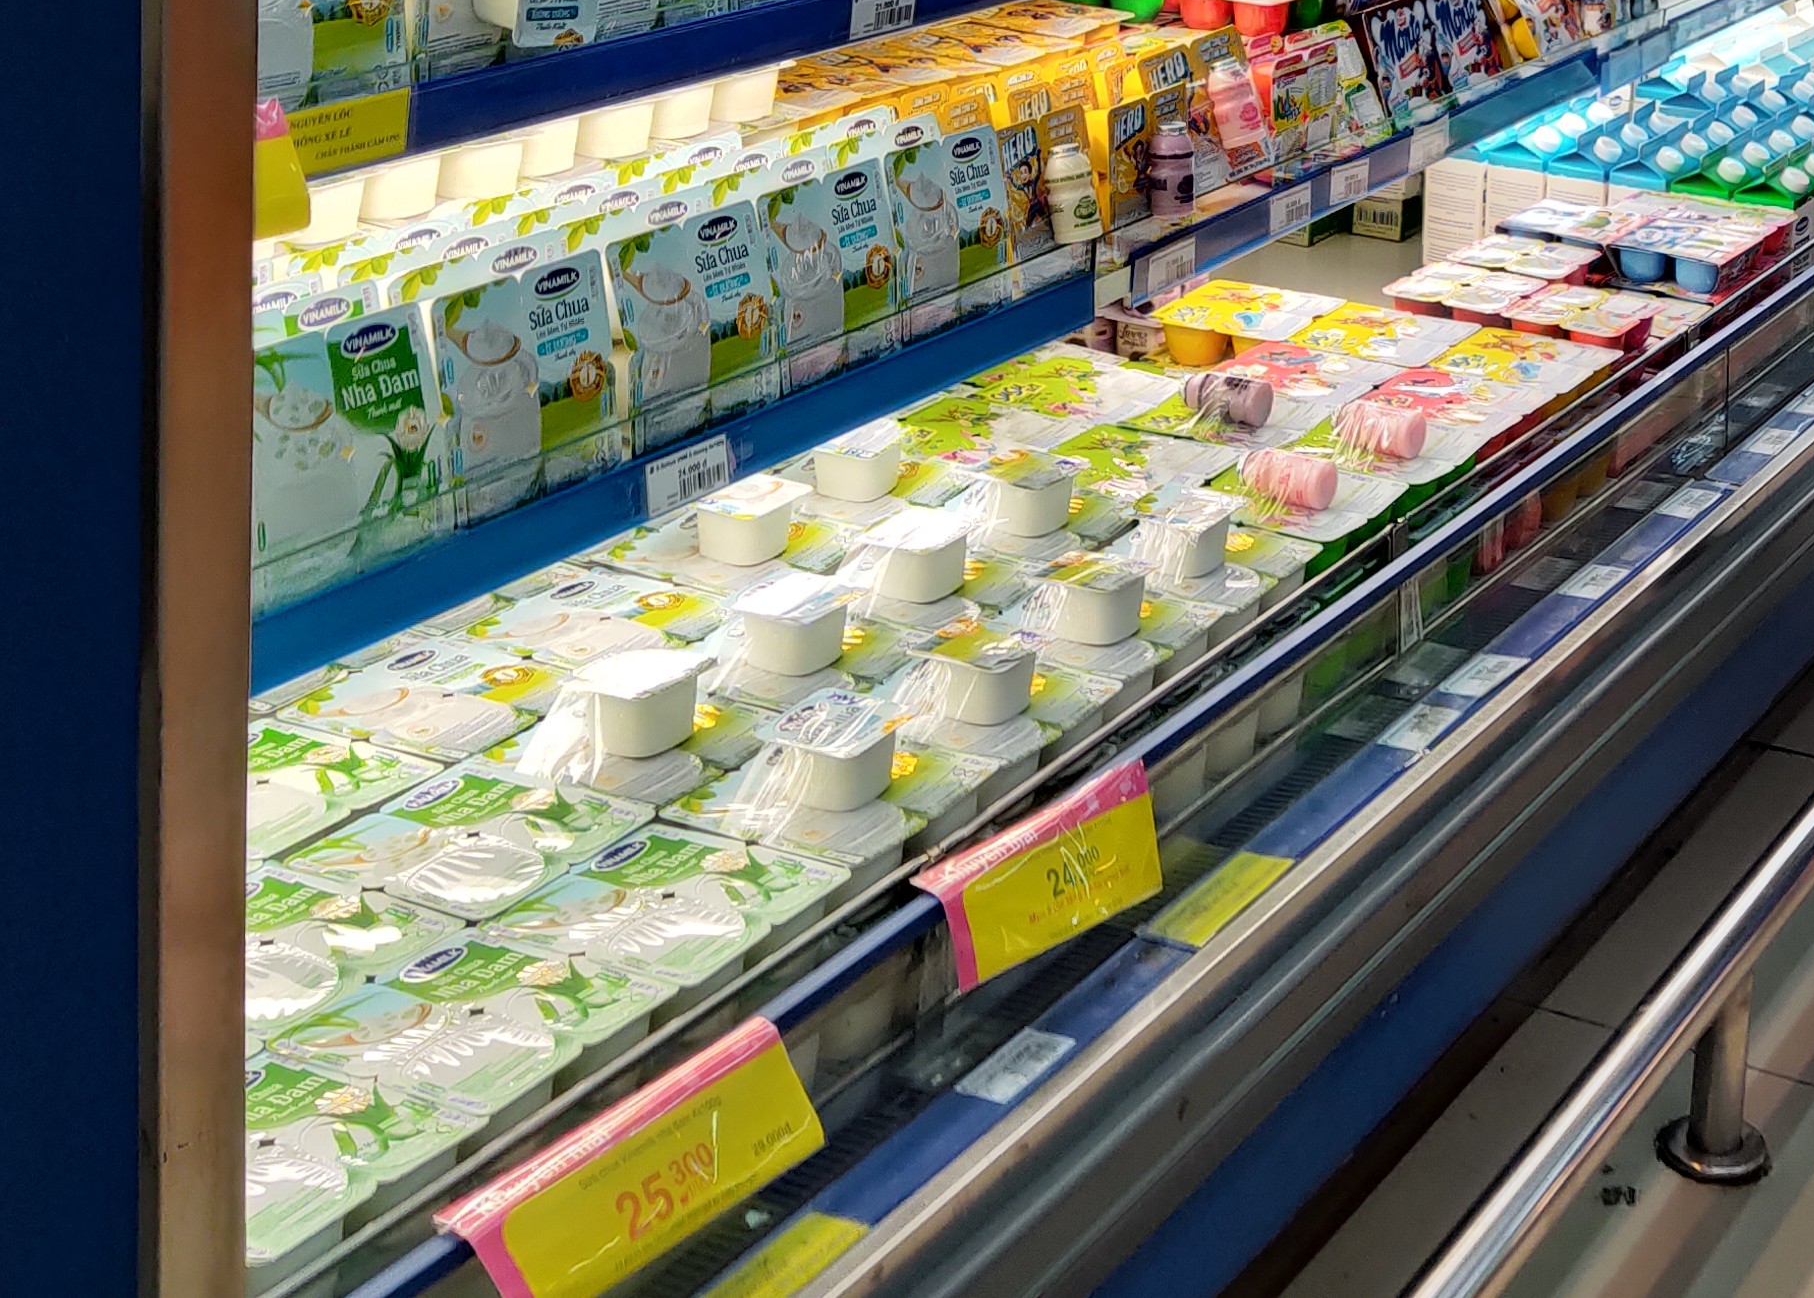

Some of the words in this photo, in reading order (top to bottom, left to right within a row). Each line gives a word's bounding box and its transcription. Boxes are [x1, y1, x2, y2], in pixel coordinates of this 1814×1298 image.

[1150, 51, 1189, 92] HERO
[1114, 105, 1145, 143] HERO
[895, 130, 924, 147] VINAMILK
[953, 142, 982, 158] VINAMILK
[1001, 126, 1037, 172] HERO
[781, 162, 816, 182] VINAMILK
[948, 166, 969, 188] Sữa
[970, 163, 990, 181] Chua
[836, 176, 867, 195] VINAMILK
[649, 205, 688, 225] VINAMILK
[831, 200, 851, 227] Sữa
[853, 195, 877, 220] Chua
[699, 217, 736, 240] VINAMILK
[494, 251, 537, 273] VINAMILK
[694, 249, 722, 275] Sữa
[724, 241, 750, 268] Chua
[537, 271, 578, 294] VINAMILK
[299, 300, 351, 325] VINAMILK
[528, 305, 552, 331] Sữa
[555, 297, 590, 323] Chua
[345, 327, 397, 353] VINAMILK
[371, 357, 397, 372] Chua
[341, 381, 377, 411] Nha
[378, 369, 419, 402] Đam
